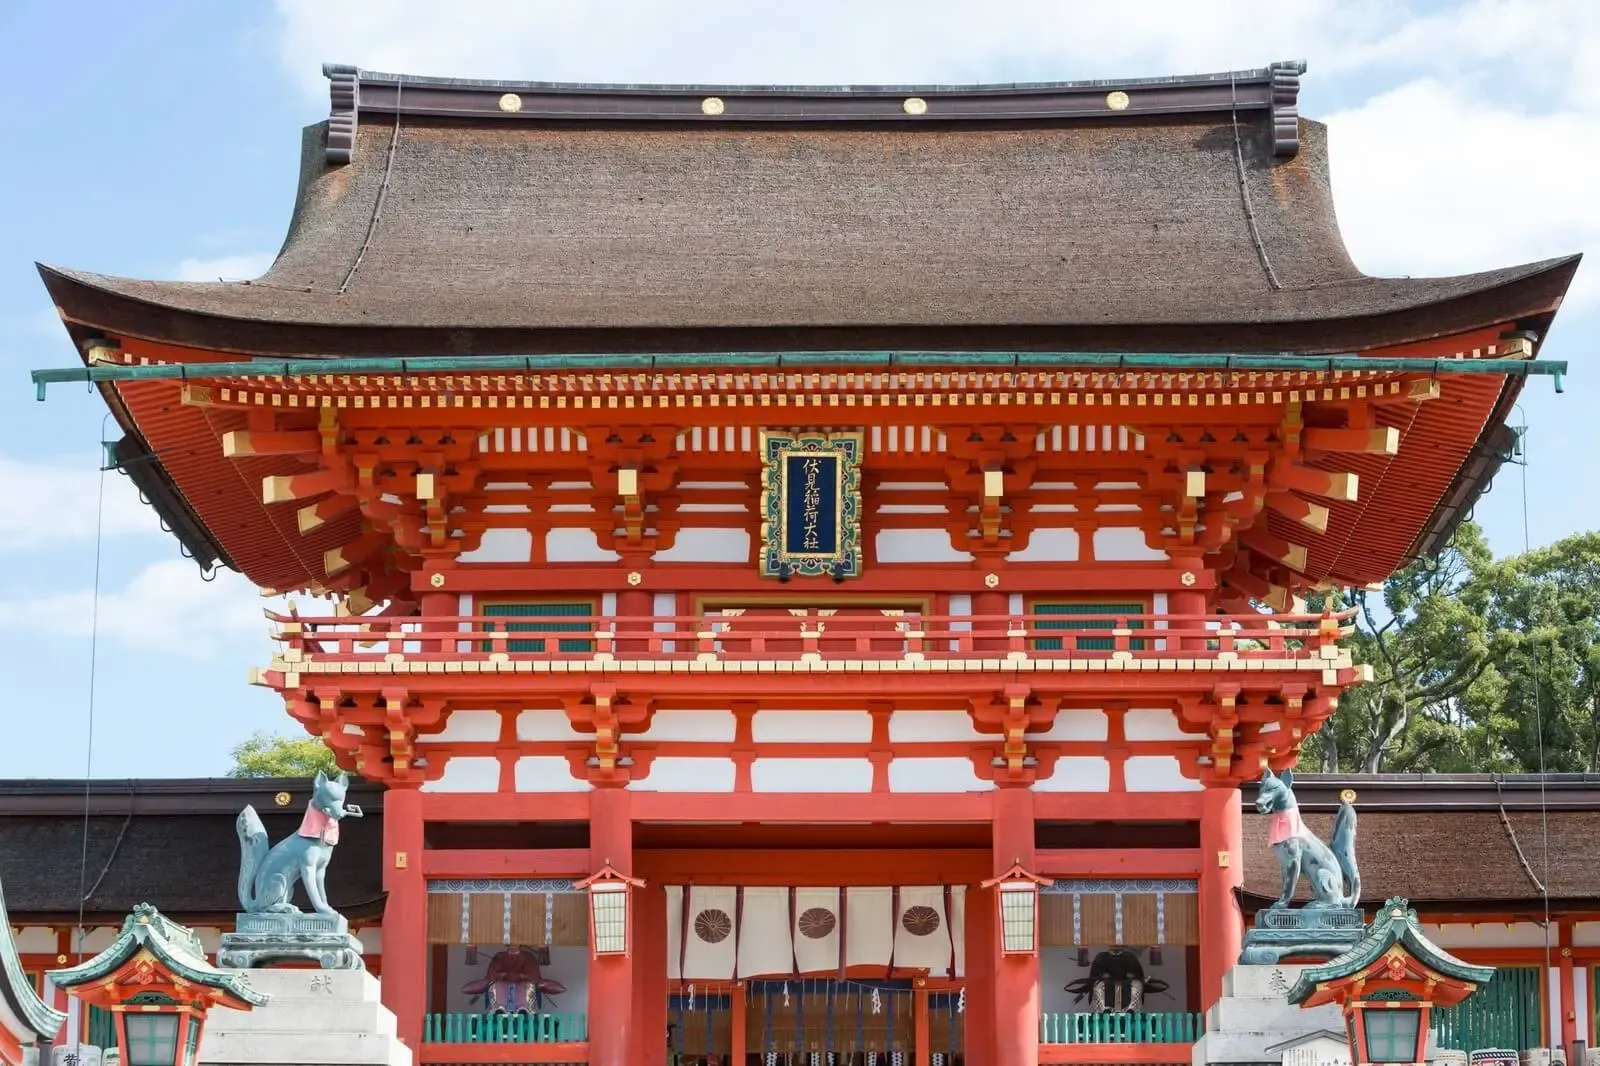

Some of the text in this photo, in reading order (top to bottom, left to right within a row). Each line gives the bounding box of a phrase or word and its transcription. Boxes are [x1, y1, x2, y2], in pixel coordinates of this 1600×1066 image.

[803, 459, 821, 549] 伏見稲荷大社
